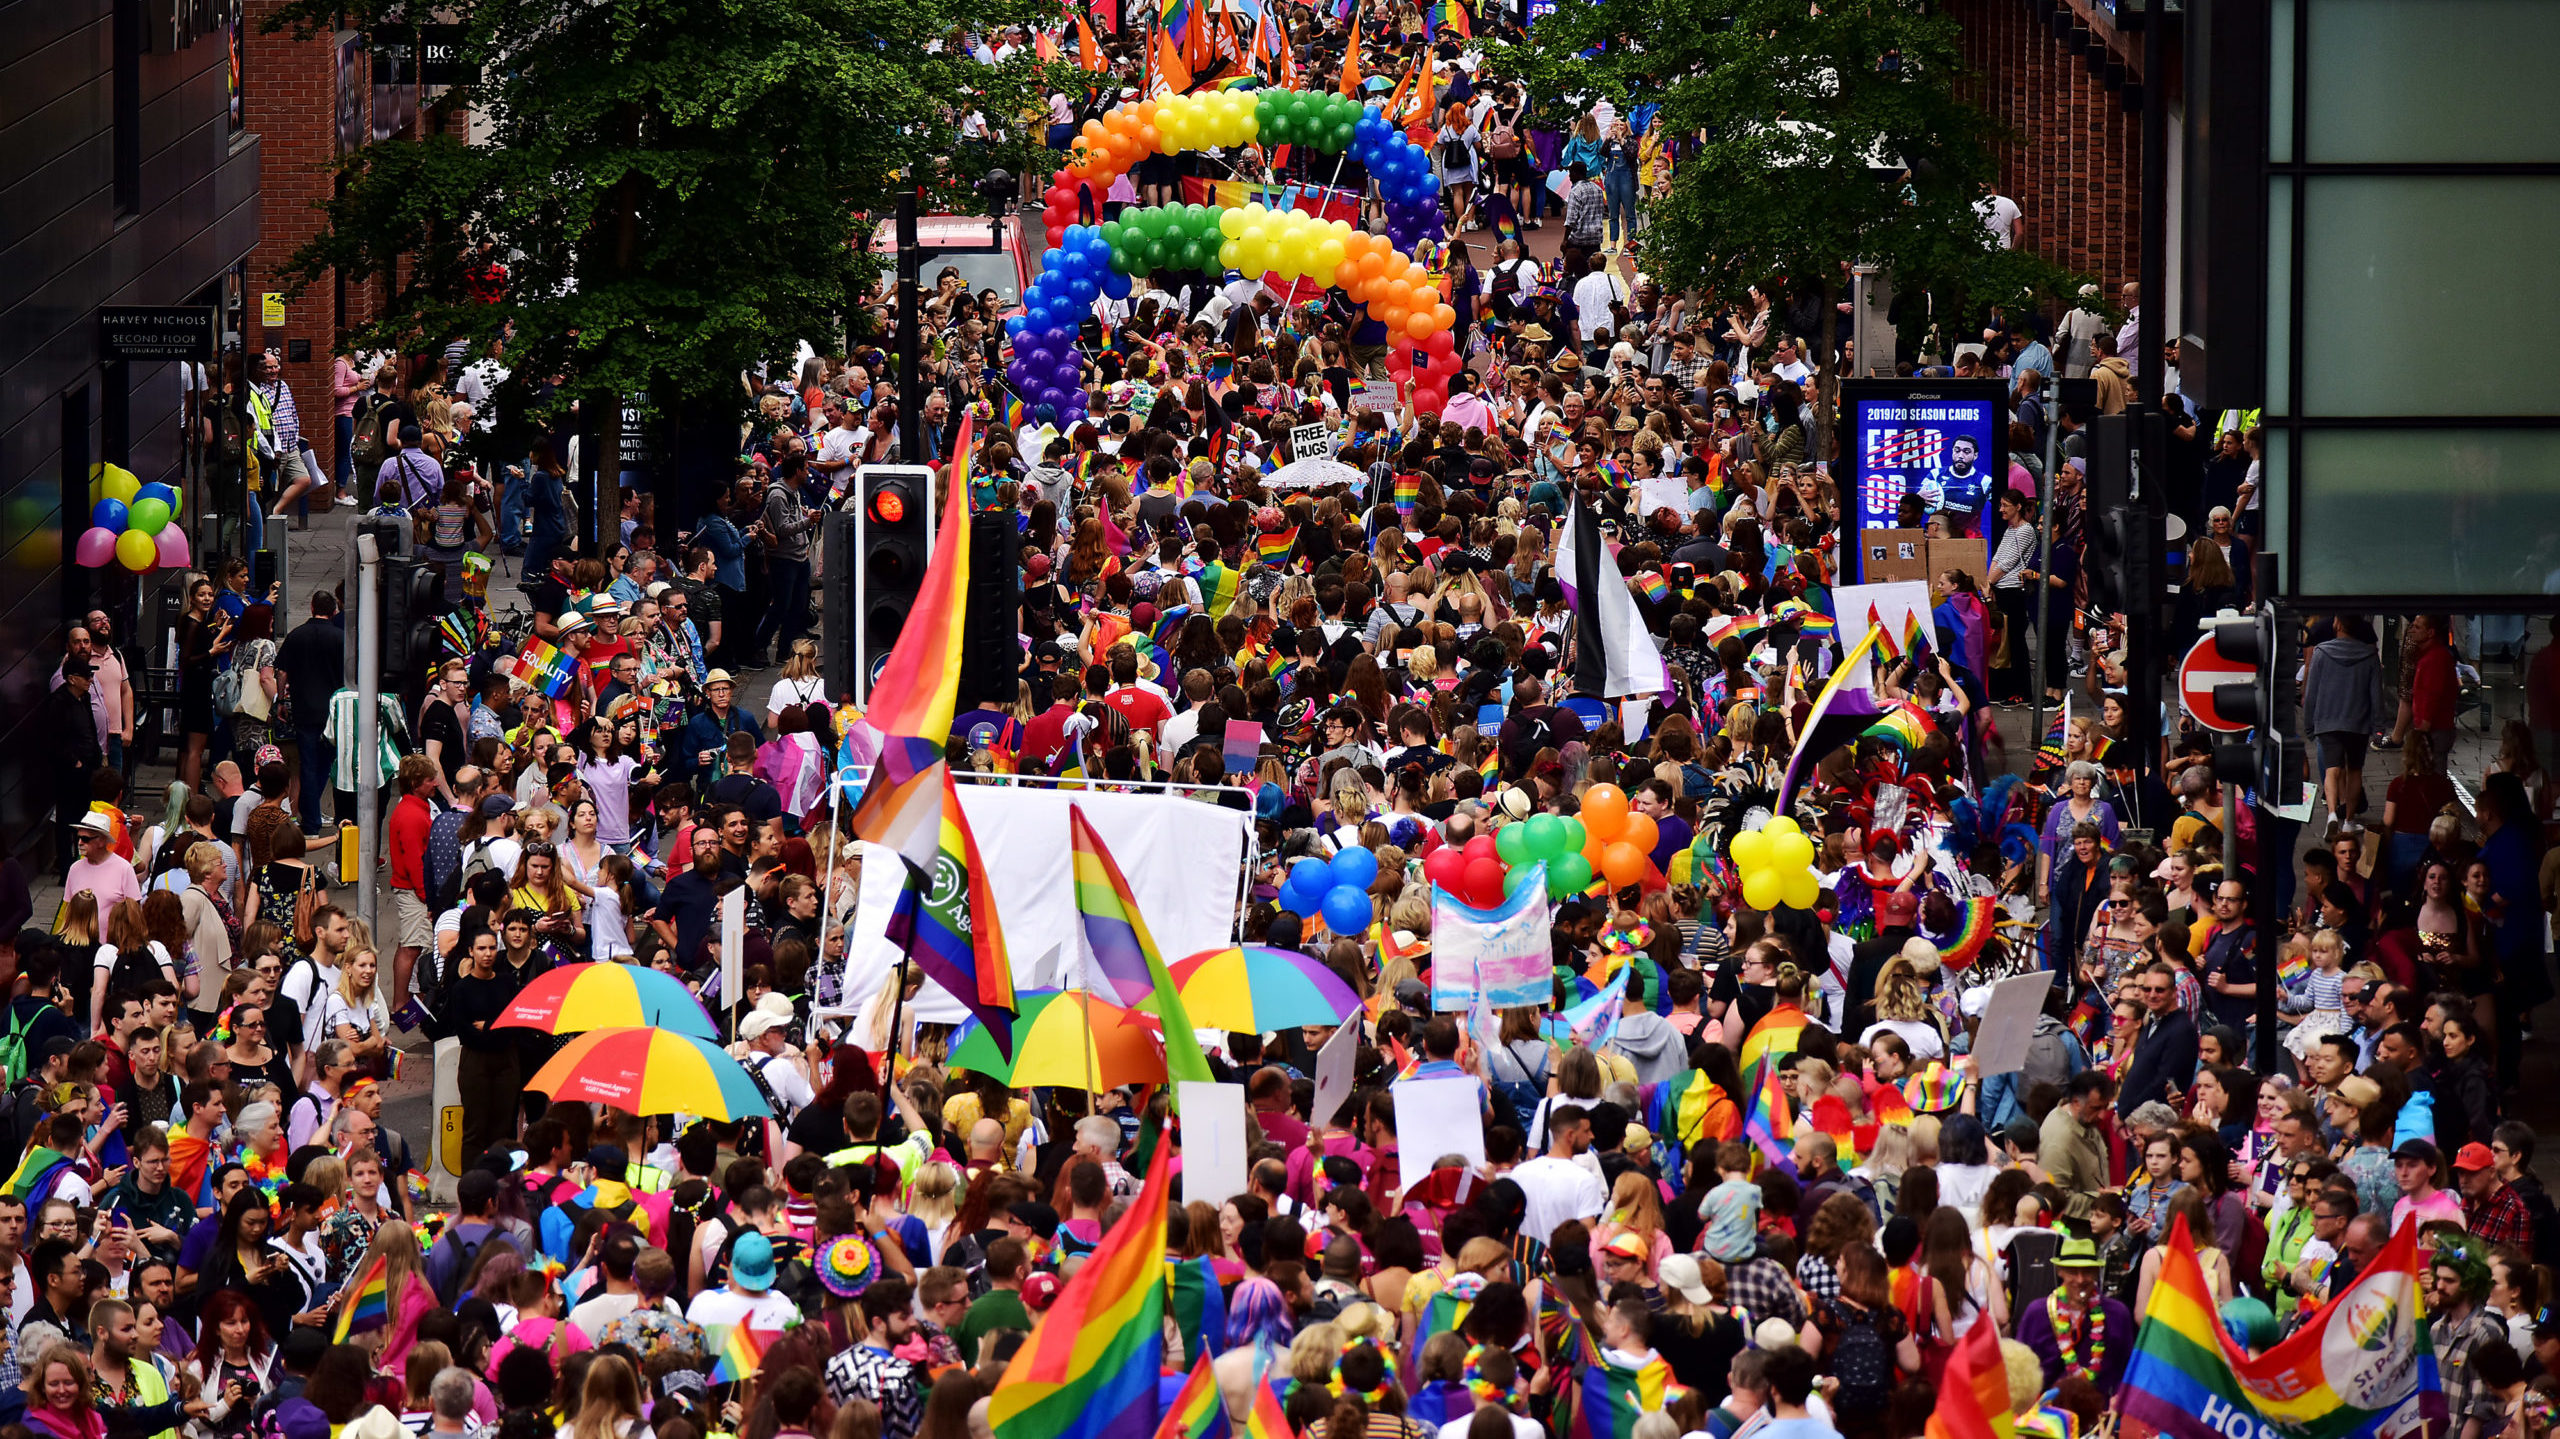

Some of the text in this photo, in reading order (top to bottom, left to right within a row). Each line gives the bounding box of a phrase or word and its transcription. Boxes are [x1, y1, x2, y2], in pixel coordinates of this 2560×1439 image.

[103, 316, 206, 325] HARVEY NICHOLS
[112, 334, 197, 344] SECOND FLOOR
[1867, 408, 1980, 421] 2019/20 SEASON CARDS
[1293, 425, 1326, 443] FREE
[1295, 441, 1328, 459] HUGS
[1867, 429, 1943, 469] FEAR
[522, 650, 573, 685] EQUALITY
[445, 1110, 454, 1121] T
[446, 1121, 455, 1132] 6
